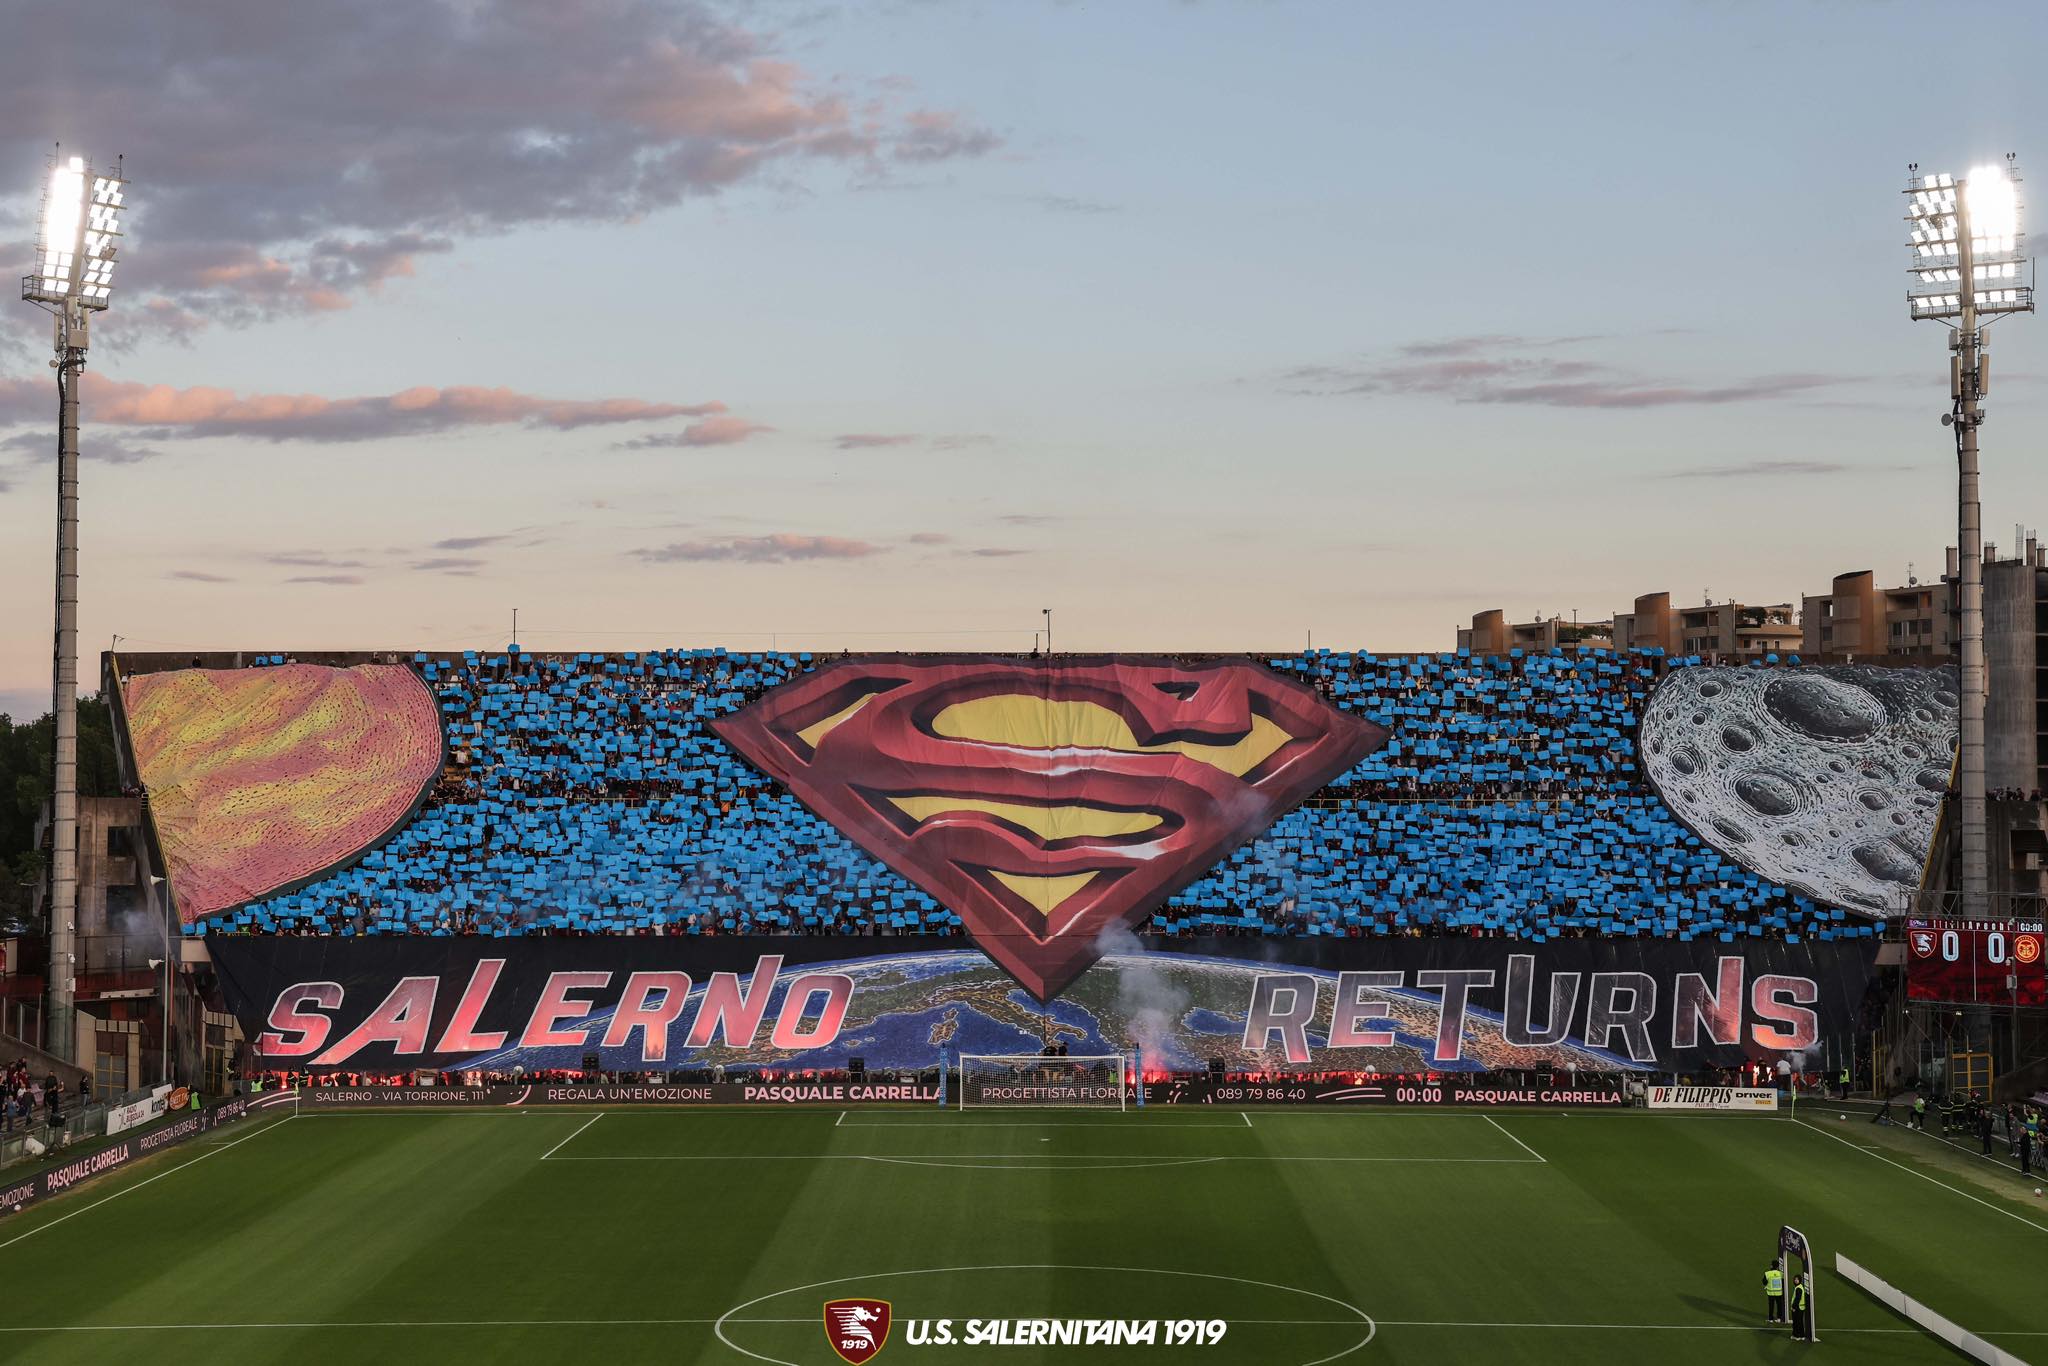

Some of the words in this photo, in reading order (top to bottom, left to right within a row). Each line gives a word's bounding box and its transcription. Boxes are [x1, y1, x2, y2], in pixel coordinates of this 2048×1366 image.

[1942, 931, 1959, 961] 0
[1988, 932, 2005, 963] 0
[260, 954, 855, 1065] SALERNO
[1242, 953, 1819, 1063] RETURNS
[315, 1091, 372, 1102] SALERNO
[382, 1091, 400, 1101] VIA
[404, 1091, 469, 1102] TORRIONE,
[471, 1090, 484, 1100] 111
[548, 1088, 605, 1100] REGALA
[744, 1086, 844, 1102] PASQUALE
[983, 1087, 1077, 1099] PROGETTISTA
[1081, 1087, 1152, 1099] FLOREAE
[1216, 1088, 1243, 1100] 089
[1246, 1088, 1263, 1100] 79
[1266, 1088, 1284, 1100] 86
[1287, 1088, 1306, 1100] 40
[1396, 1088, 1442, 1102] 00:00
[1455, 1090, 1537, 1104] PASQUALE
[1540, 1090, 1622, 1103] CARRELLA
[1653, 1087, 1672, 1103] DE
[1674, 1087, 1733, 1104] FILIPPIS
[140, 1126, 174, 1151] PROGETTISTA
[174, 1116, 198, 1138] FLOREALE
[47, 1160, 90, 1191] PASQUALE
[90, 1144, 129, 1173] CARRELLA
